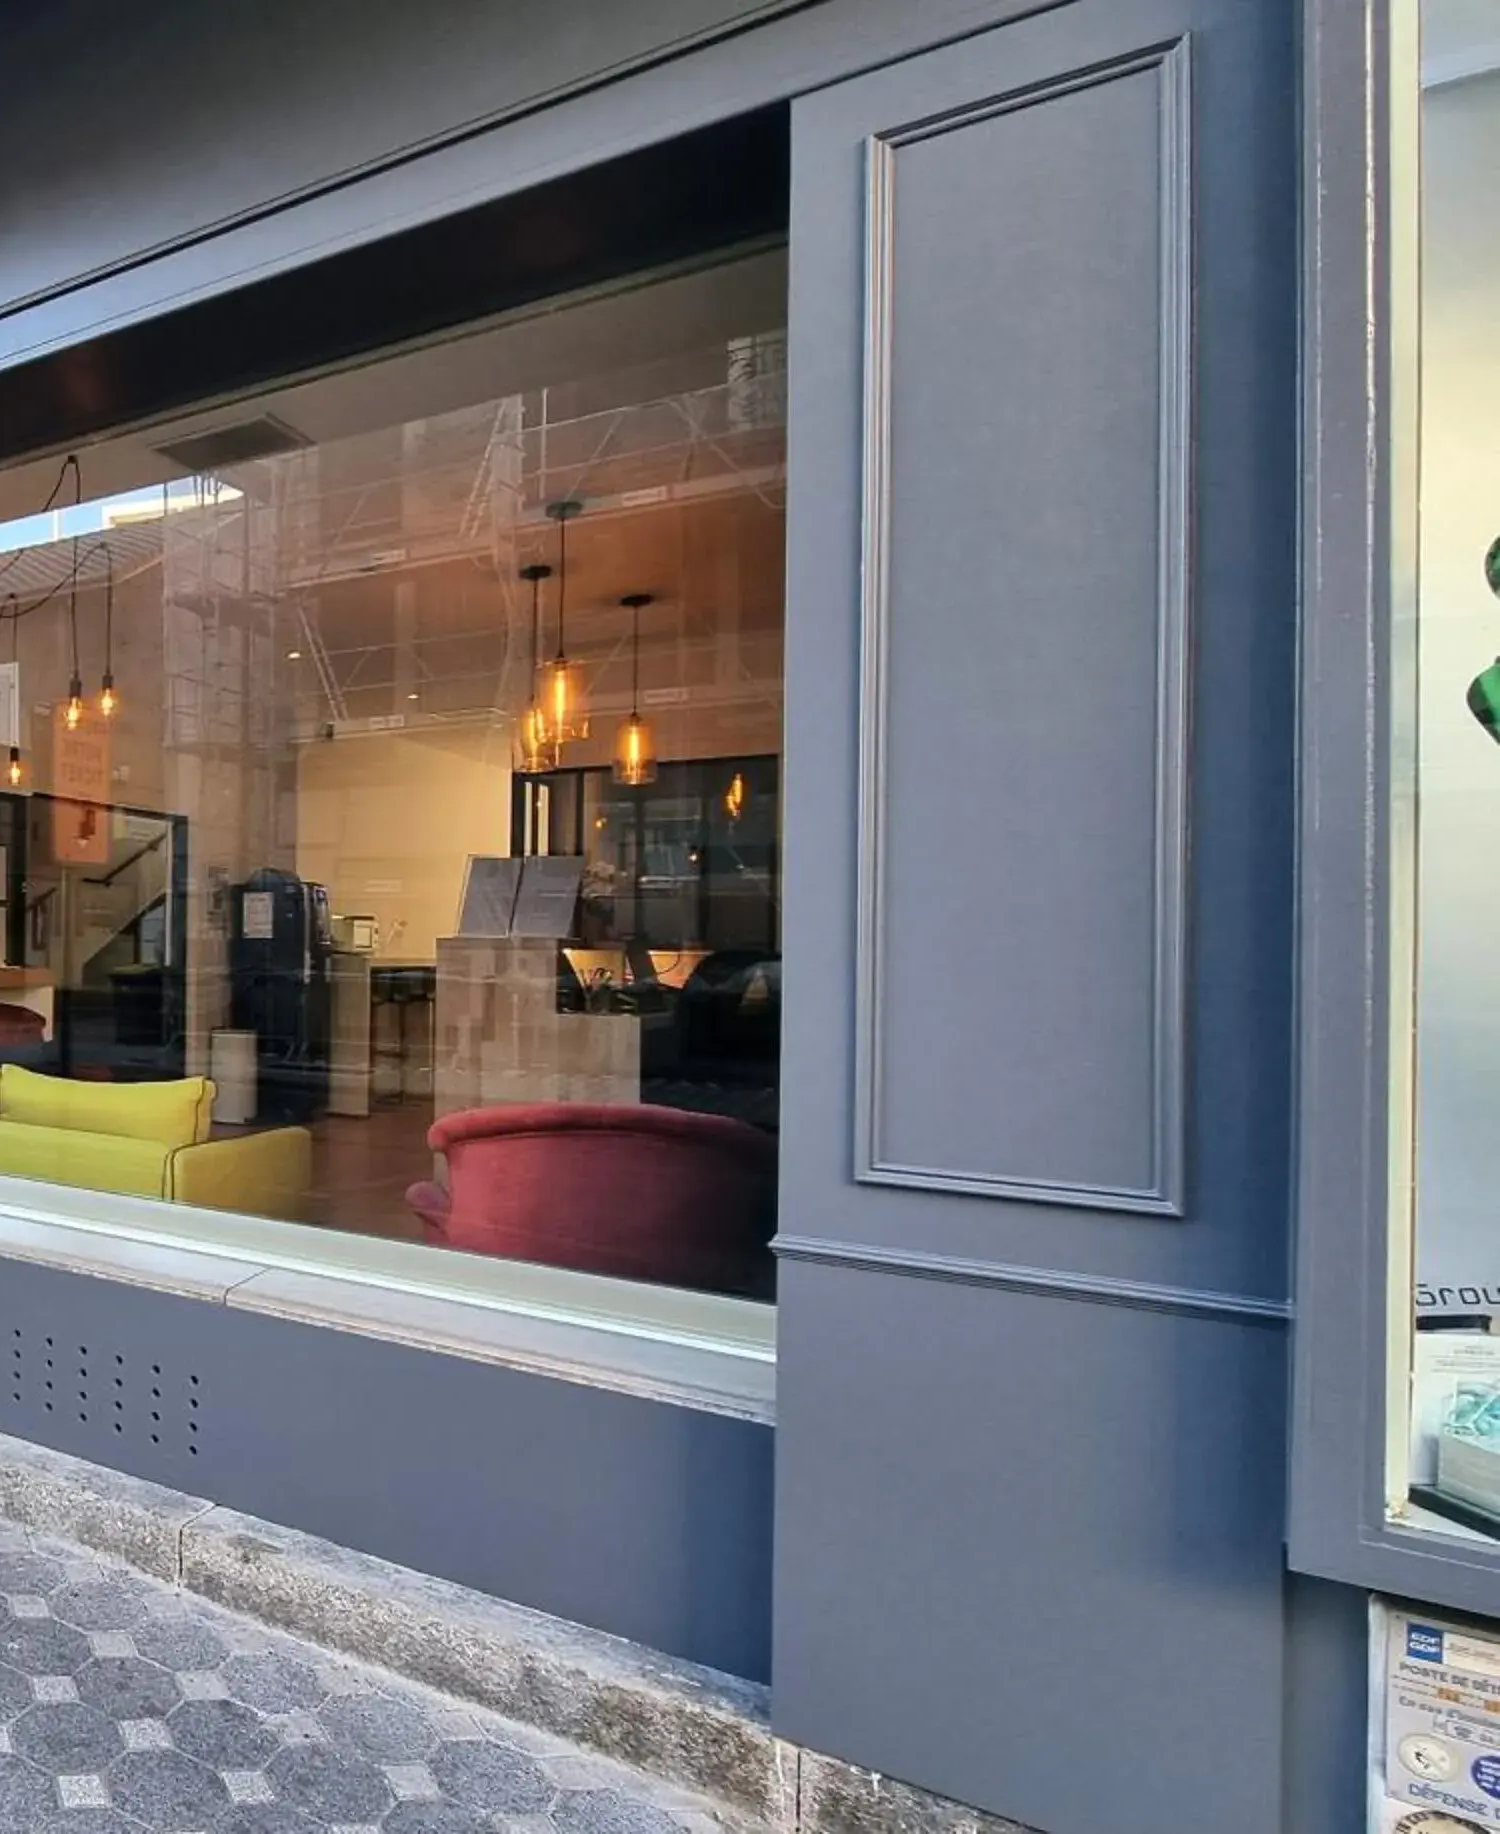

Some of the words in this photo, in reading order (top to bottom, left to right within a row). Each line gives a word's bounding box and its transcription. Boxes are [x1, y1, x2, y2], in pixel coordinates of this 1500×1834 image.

[1399, 1661, 1449, 1683] POSTE
[1451, 1674, 1470, 1688] DE
[1471, 1679, 1500, 1696] DÉT
[1408, 1782, 1489, 1818] DÉFENSE
